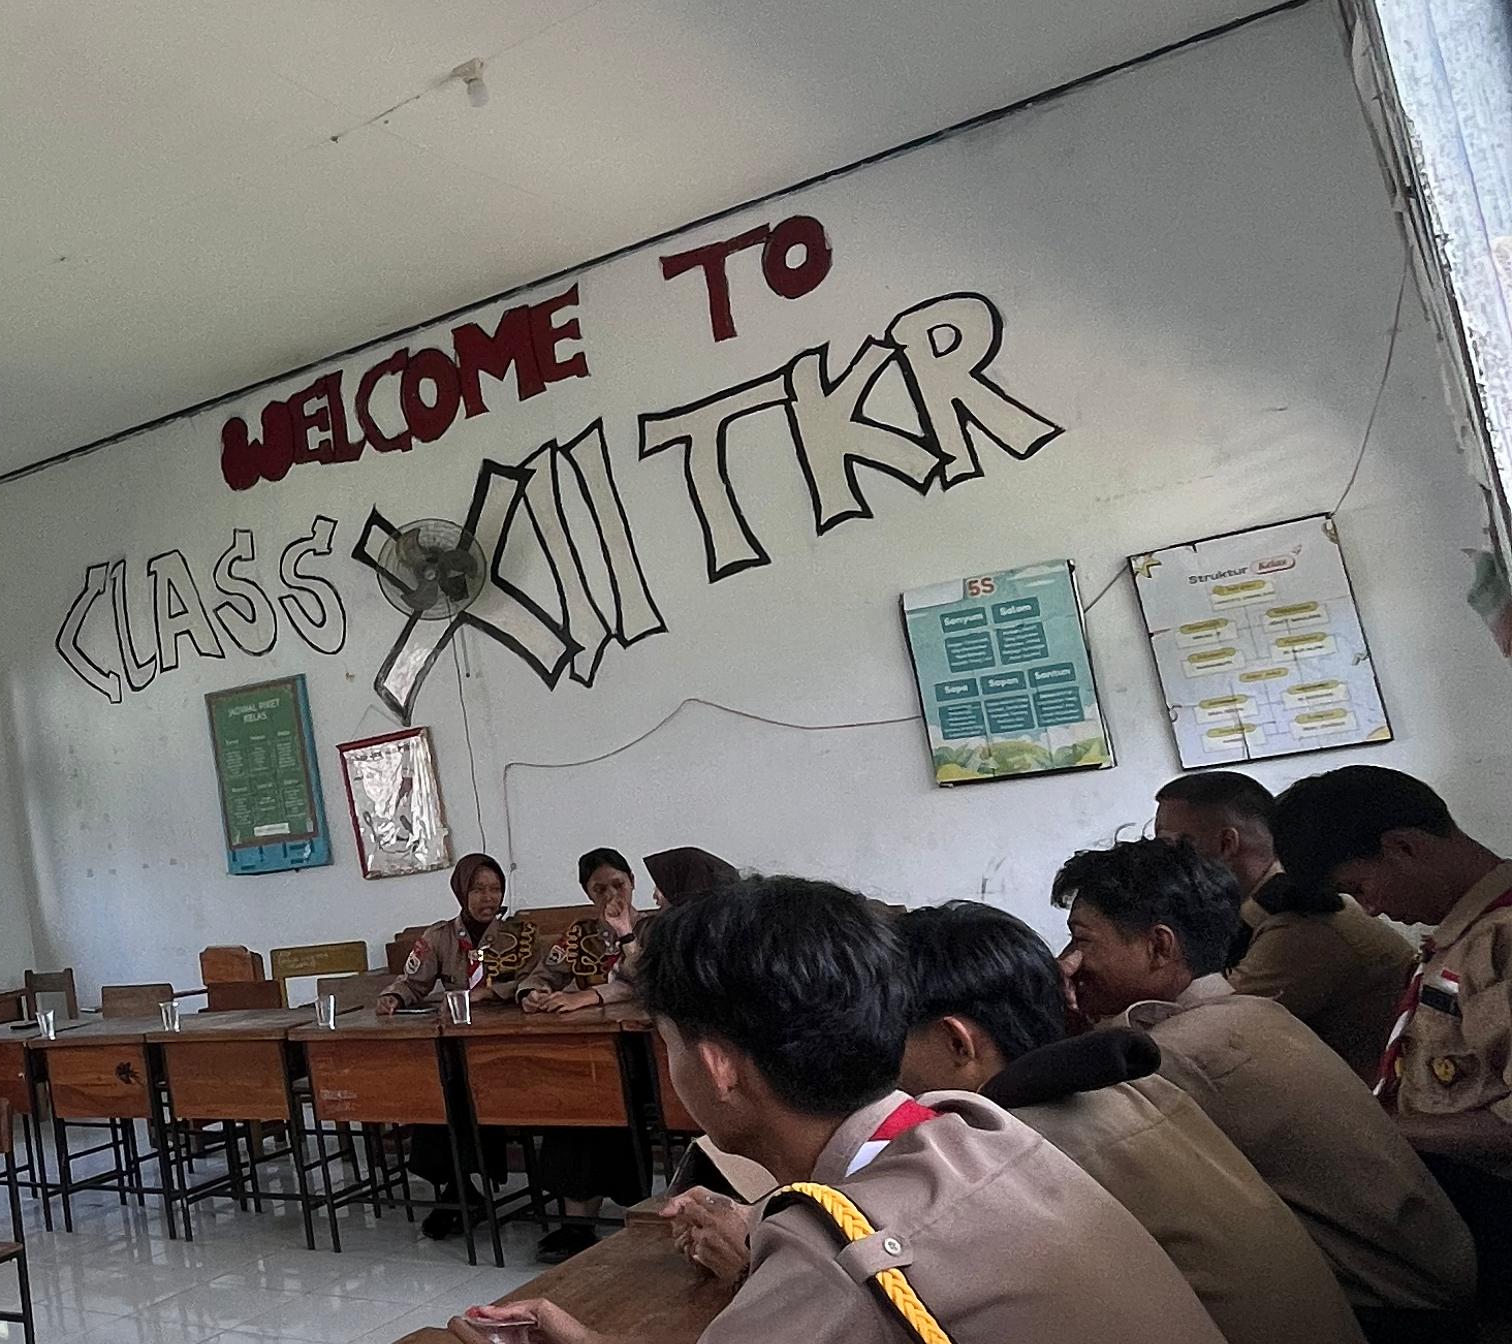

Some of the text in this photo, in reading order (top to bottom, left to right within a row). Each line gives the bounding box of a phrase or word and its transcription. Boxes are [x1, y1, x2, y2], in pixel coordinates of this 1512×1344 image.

[220, 214, 833, 491] WELCOME TO
[55, 291, 1065, 726] CLASS XII TKR
[1188, 567, 1249, 584] Struktur
[967, 577, 995, 597] 5S
[1000, 603, 1032, 616] Salam
[988, 677, 1019, 688] Sopan
